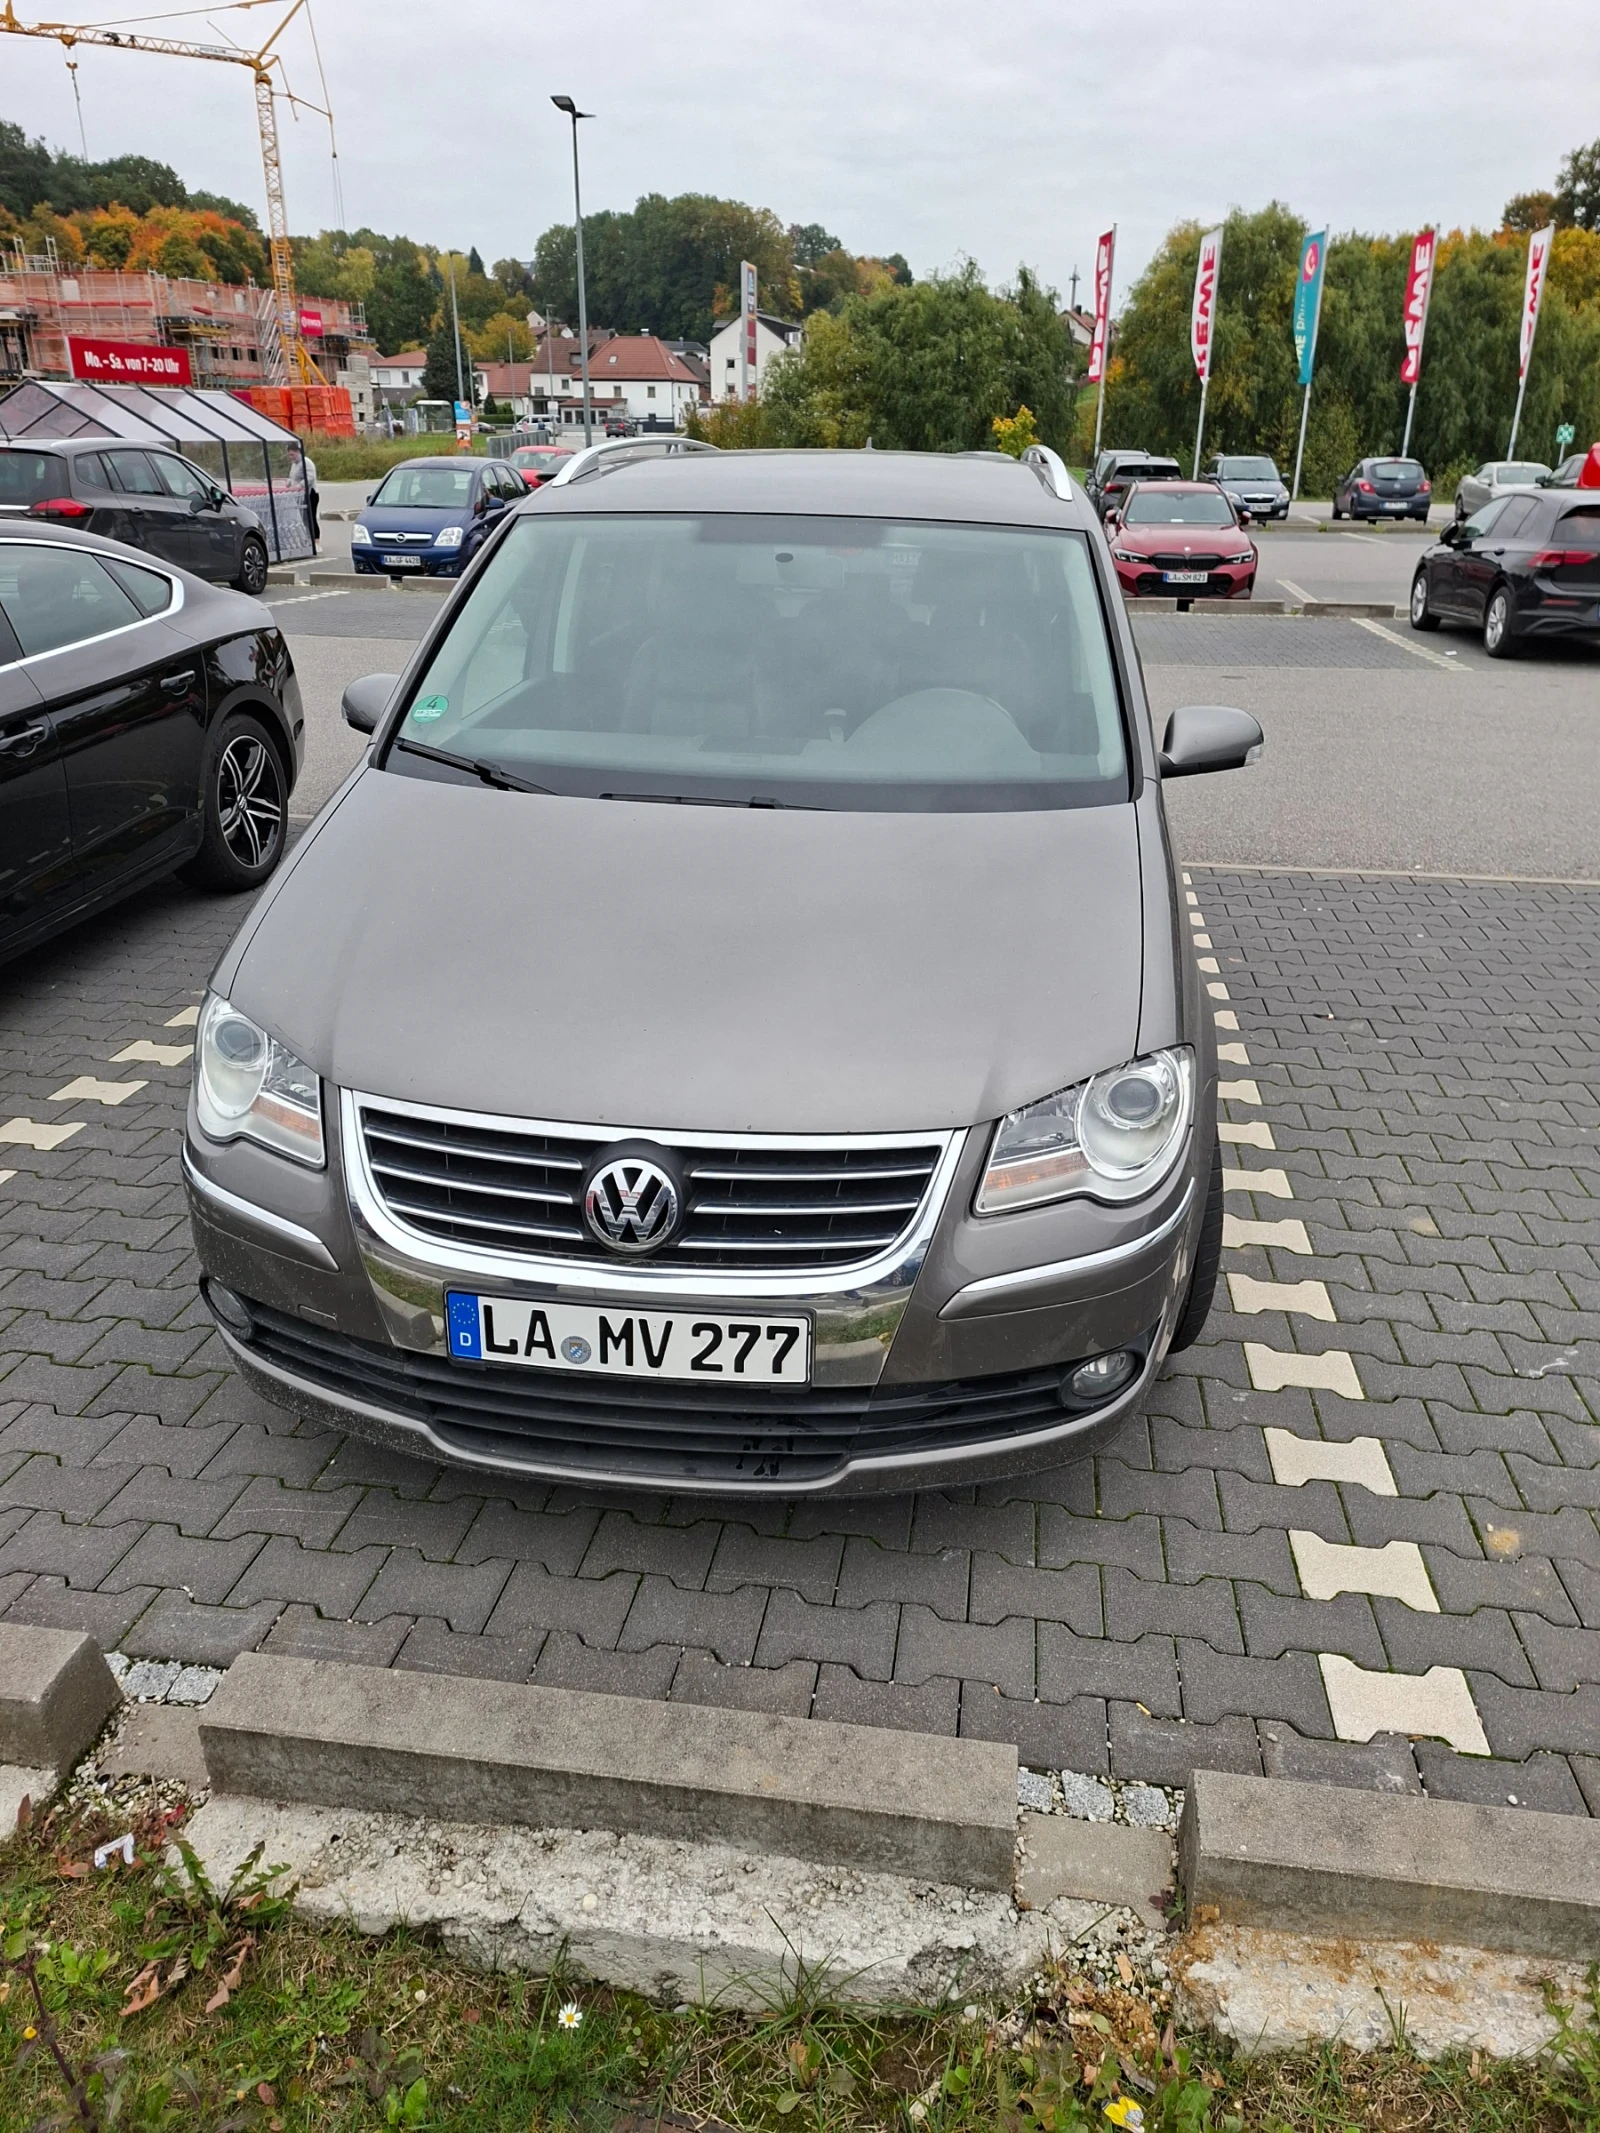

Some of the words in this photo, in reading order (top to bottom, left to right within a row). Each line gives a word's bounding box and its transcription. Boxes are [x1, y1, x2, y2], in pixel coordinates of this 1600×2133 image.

[124, 358, 142, 370] von
[164, 358, 179, 373] Uhr
[1168, 573, 1177, 581] LA
[426, 696, 439, 709] 4
[459, 1332, 472, 1347] D
[483, 1304, 556, 1360] LA
[599, 1314, 674, 1369] MV
[690, 1321, 801, 1374] 277
